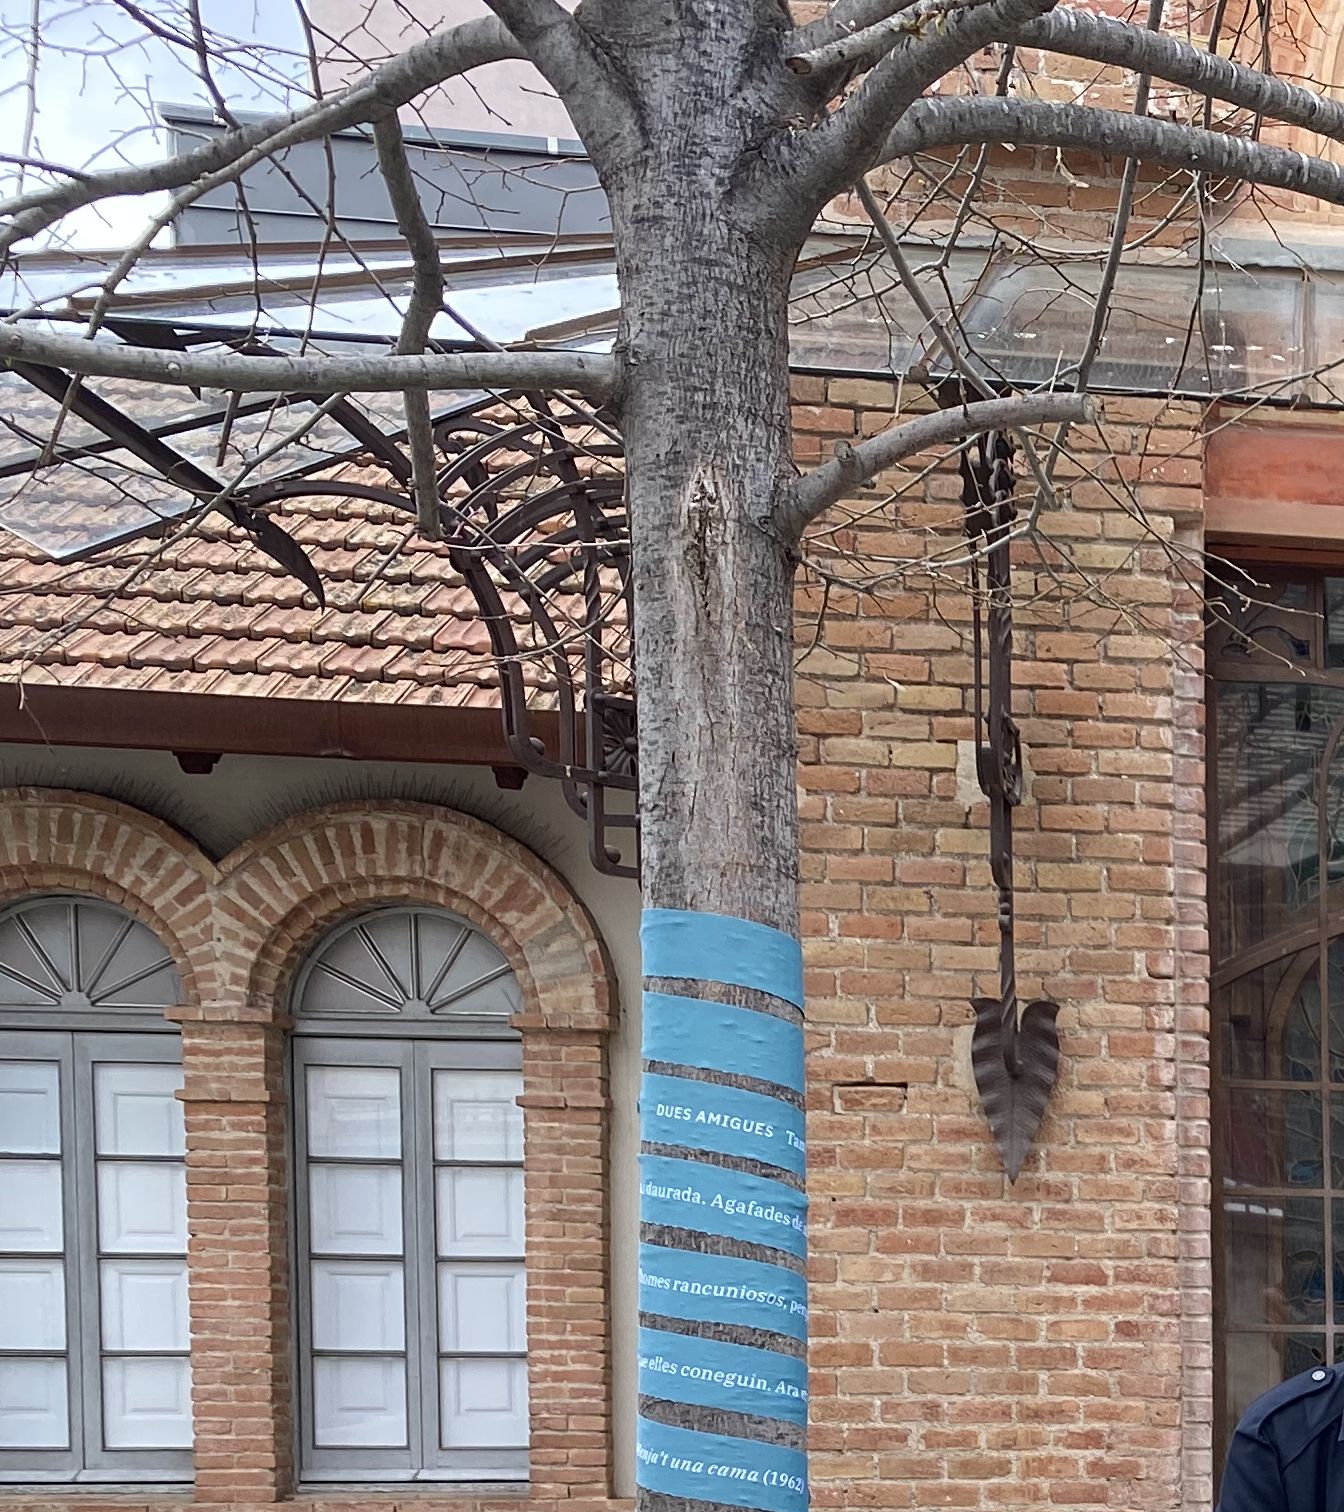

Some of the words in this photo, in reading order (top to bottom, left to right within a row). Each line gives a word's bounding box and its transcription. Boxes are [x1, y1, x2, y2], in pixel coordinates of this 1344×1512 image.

[656, 1104, 691, 1120] DUES
[695, 1111, 774, 1137] AMIGUES
[710, 1193, 790, 1225] Agafades
[673, 1279, 787, 1310] rancuniosos,
[681, 1364, 771, 1391] coneguin.
[775, 1380, 798, 1398] Ara
[670, 1458, 703, 1472] una
[707, 1465, 759, 1482] cama
[763, 1469, 804, 1494] (1962)
